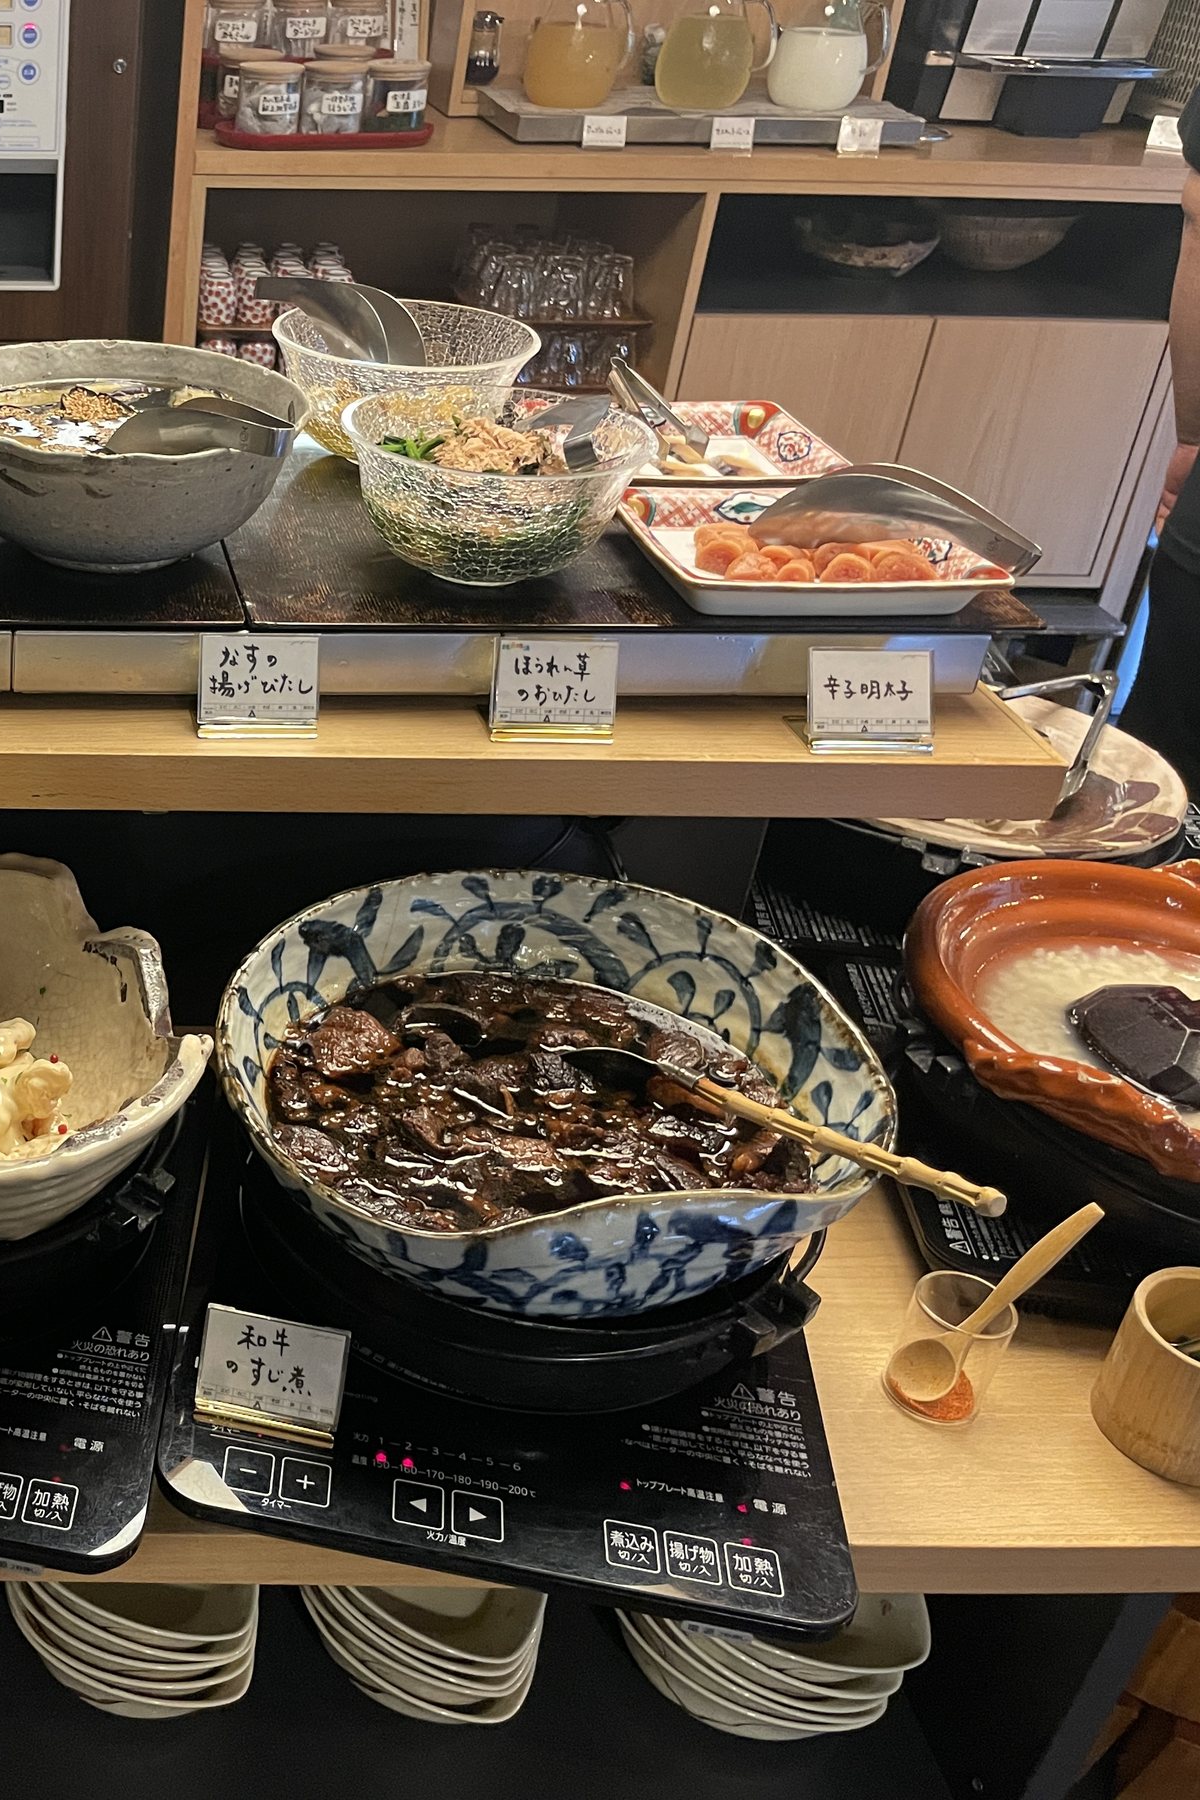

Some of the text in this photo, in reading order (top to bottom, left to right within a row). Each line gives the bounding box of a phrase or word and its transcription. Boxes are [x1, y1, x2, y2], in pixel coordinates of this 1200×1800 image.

[219, 644, 278, 673] なすの
[515, 652, 590, 682] ほうれん草
[209, 670, 313, 698] 揚げびたし
[518, 684, 596, 706] のおひたし
[823, 674, 913, 701] 辛子明太子
[116, 1329, 150, 1347] 警告
[237, 1324, 290, 1356] 和牛
[71, 1340, 150, 1361] 火災の恐れあり
[226, 1357, 312, 1397] のすじ煮
[756, 1387, 797, 1407] 警告
[73, 1437, 104, 1452] 電源
[32, 1489, 69, 1511] 加熱
[261, 1498, 291, 1509] タイマー
[752, 1498, 787, 1515] 電源
[34, 1508, 63, 1522] 切/入
[610, 1530, 654, 1553] 煮込み
[617, 1550, 650, 1565] 切/入
[668, 1540, 714, 1566] 揚げ物
[678, 1561, 712, 1577] 切/入
[732, 1553, 774, 1577] 加熱
[739, 1573, 773, 1588] 切/入
